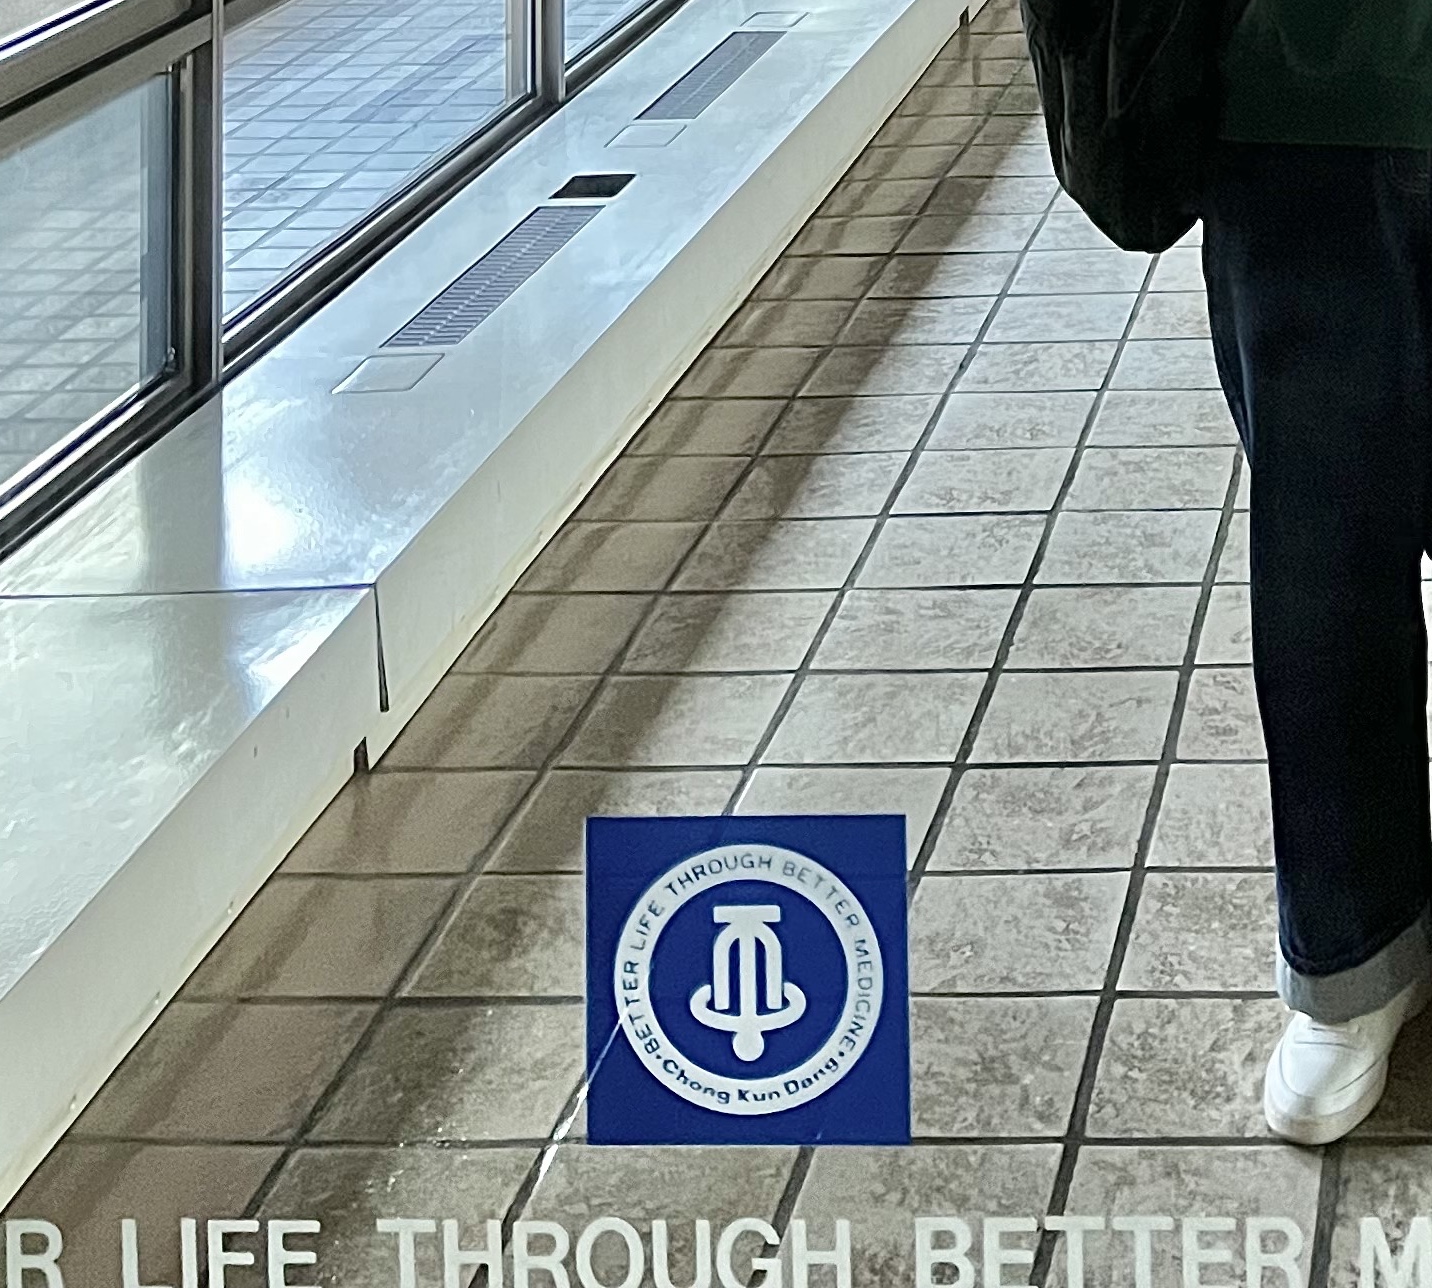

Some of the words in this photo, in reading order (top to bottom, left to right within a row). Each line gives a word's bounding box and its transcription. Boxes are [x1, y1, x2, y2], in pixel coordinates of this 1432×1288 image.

[664, 853, 772, 896] THROUGH
[782, 861, 860, 927] BETTER
[630, 899, 666, 952] LIFE
[623, 960, 660, 1054] BETTER
[839, 938, 873, 1052] MEDICINE
[663, 1059, 731, 1104] Chong
[738, 1088, 781, 1102] Kun
[784, 1057, 839, 1095] Dang
[121, 1217, 323, 1288] LIFE
[376, 1216, 851, 1288] THROUGH
[913, 1213, 1305, 1288] BETTER
